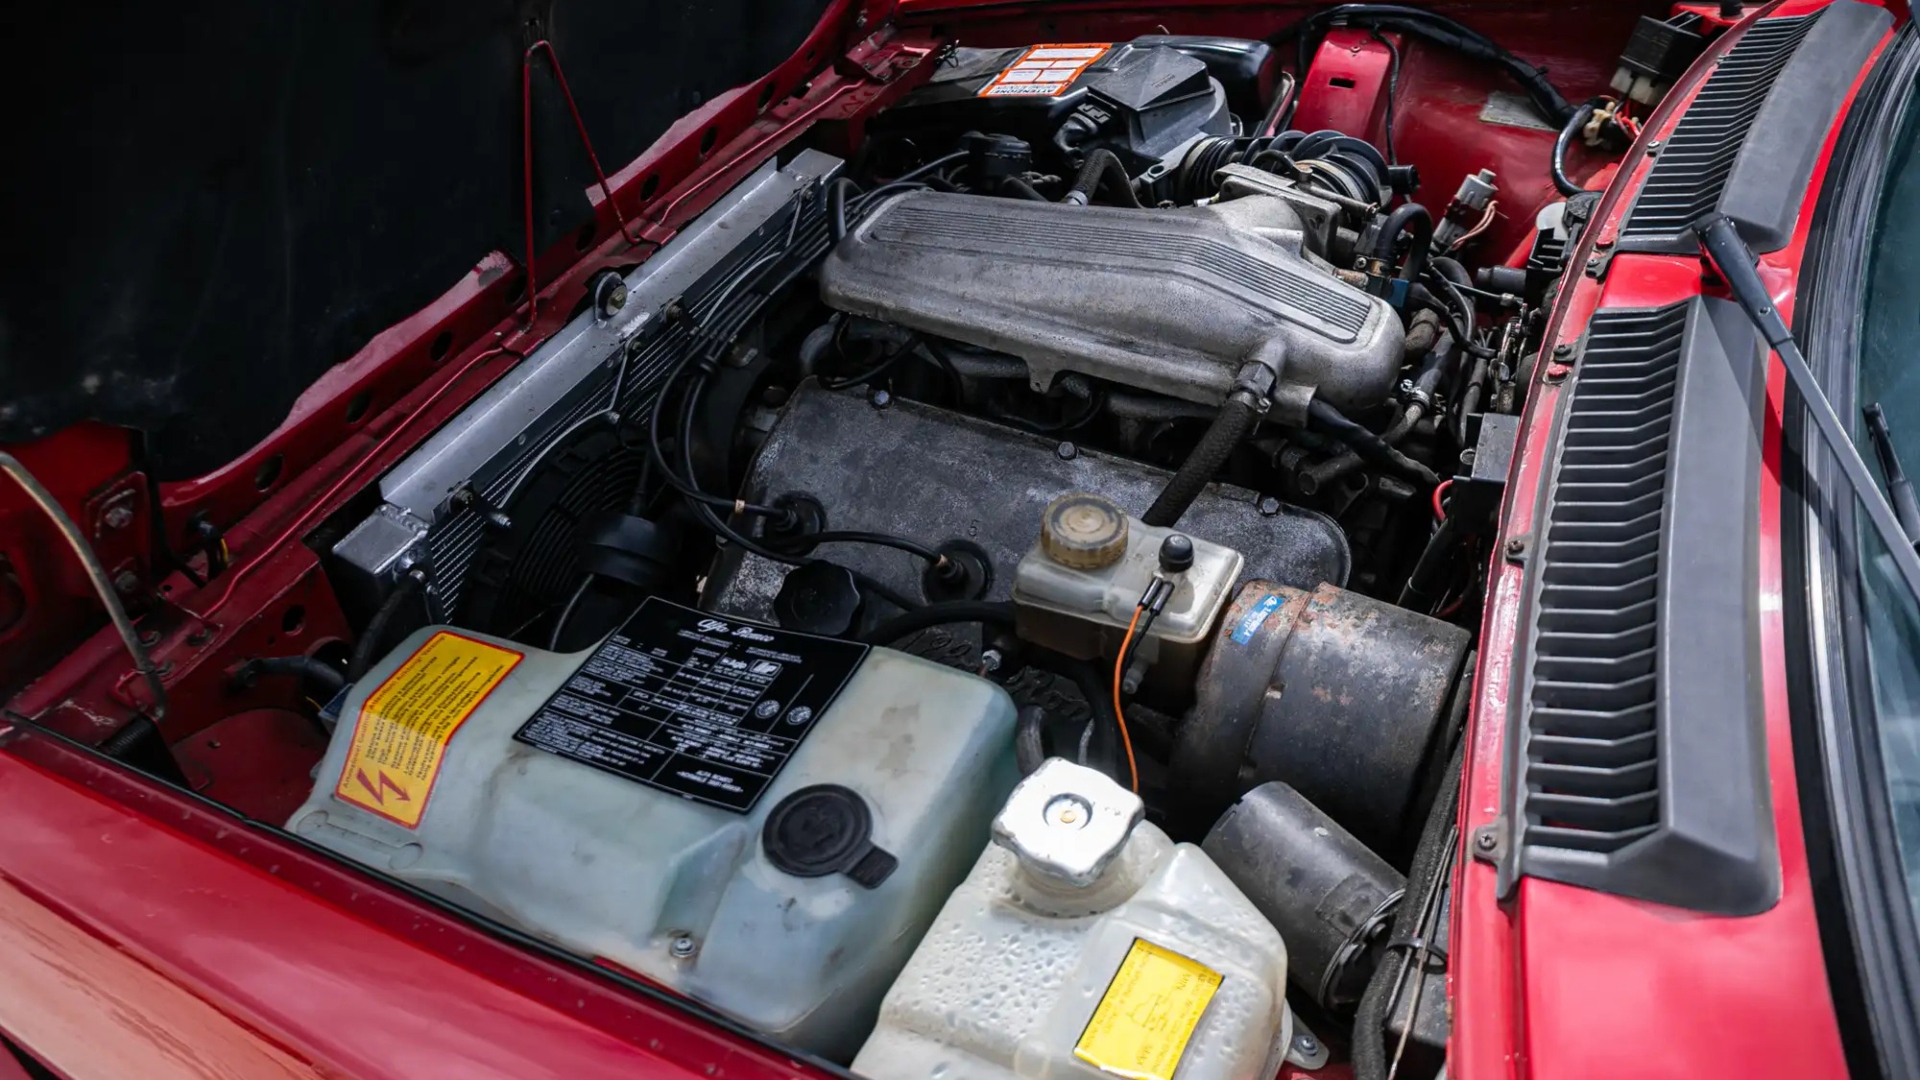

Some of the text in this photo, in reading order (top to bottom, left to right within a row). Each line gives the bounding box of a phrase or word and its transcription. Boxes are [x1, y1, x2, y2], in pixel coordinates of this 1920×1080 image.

[967, 519, 980, 537] 5
[697, 618, 729, 633] Alfa
[731, 626, 775, 642] Romeo
